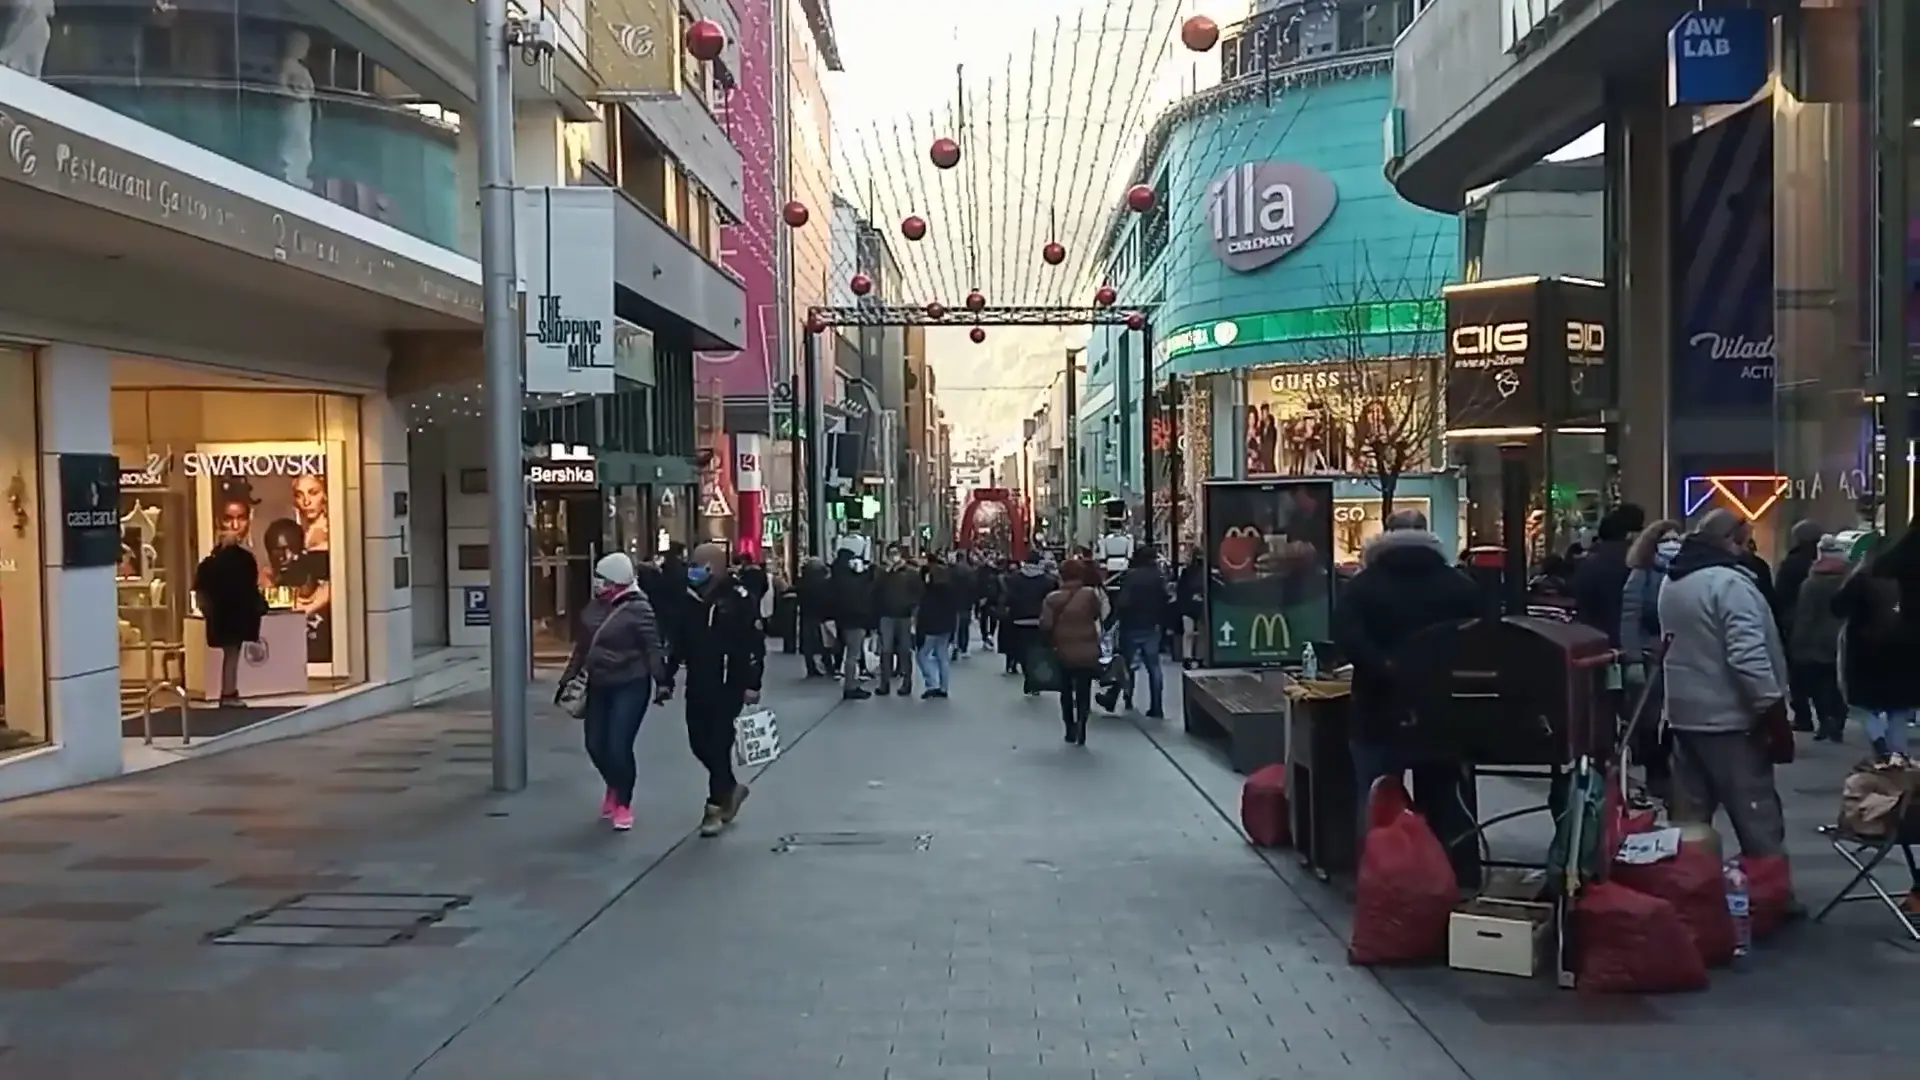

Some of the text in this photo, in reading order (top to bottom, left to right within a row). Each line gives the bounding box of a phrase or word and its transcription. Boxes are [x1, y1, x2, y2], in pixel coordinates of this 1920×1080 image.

[1684, 17, 1725, 36] AW
[1683, 38, 1730, 57] LAB
[1211, 161, 1294, 241] illa
[538, 294, 561, 319] THE
[538, 320, 601, 344] SHOPPING
[568, 344, 596, 368] MILE
[183, 451, 325, 477] SWAROVSKI
[530, 465, 594, 483] Bershka
[67, 511, 91, 526] casa
[469, 591, 485, 609] P
